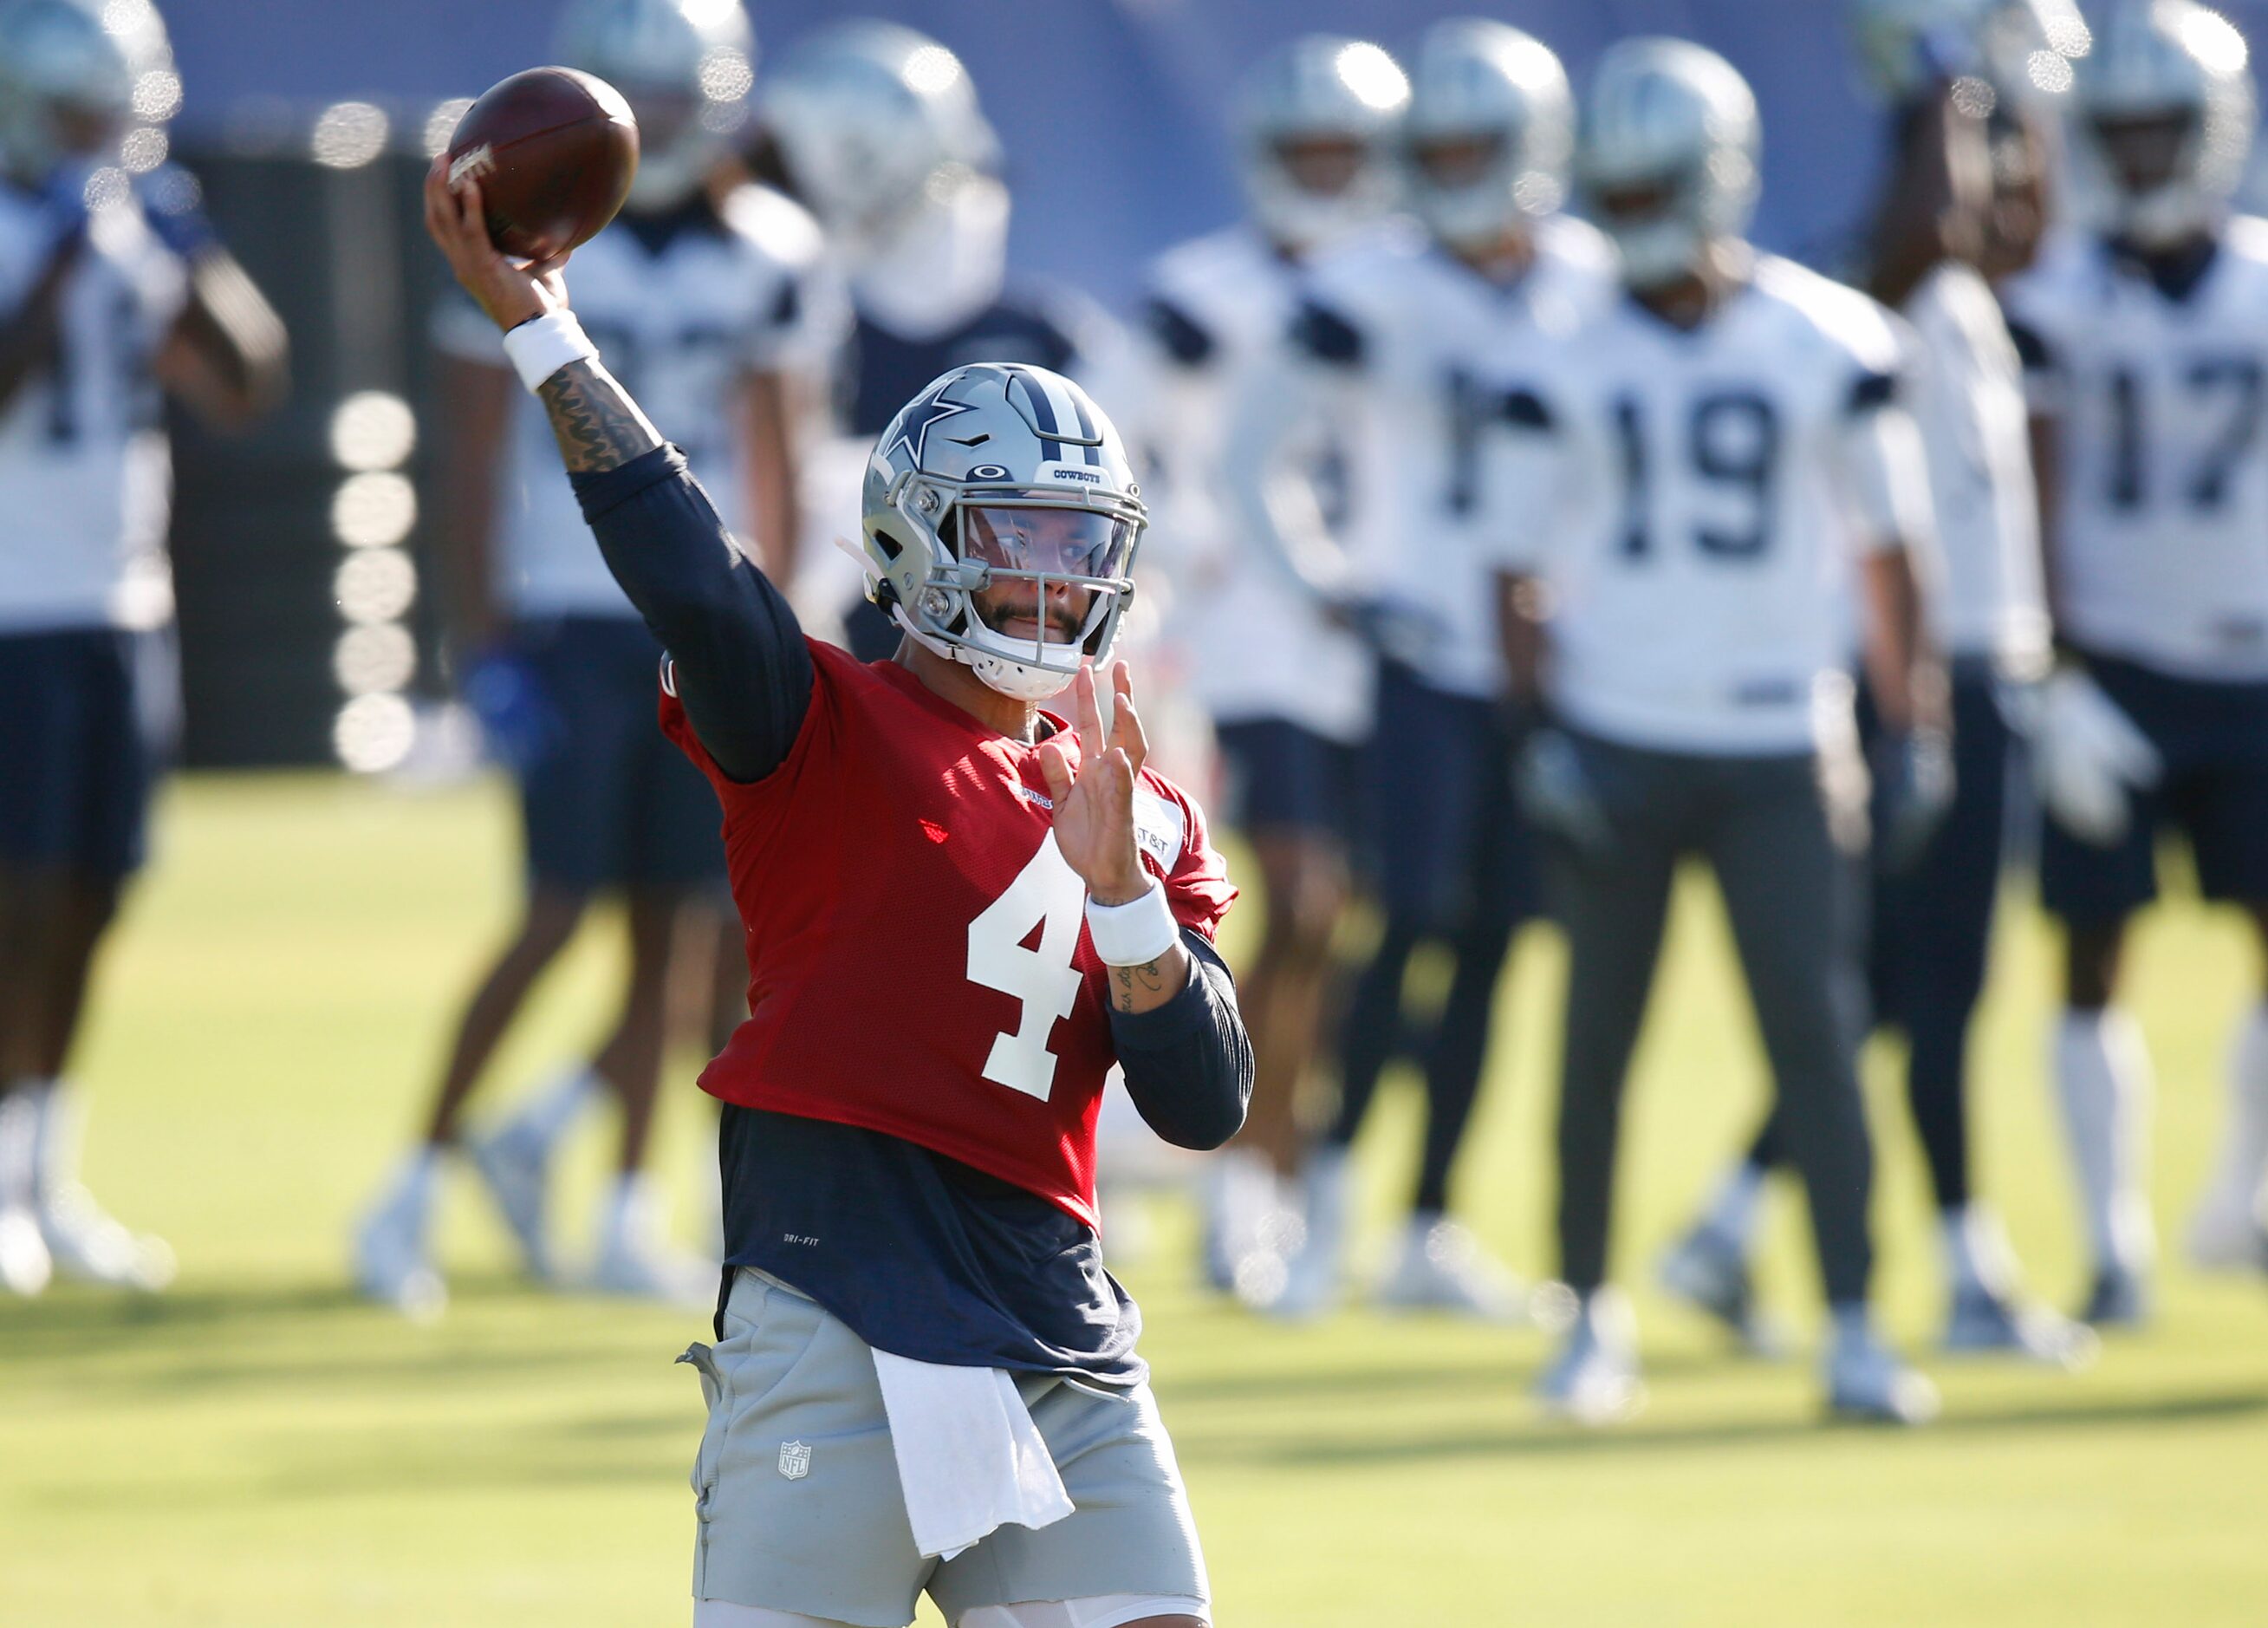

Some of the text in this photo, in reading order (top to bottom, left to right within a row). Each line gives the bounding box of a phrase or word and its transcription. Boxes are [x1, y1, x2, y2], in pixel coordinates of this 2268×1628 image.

[1054, 470, 1101, 484] COWBOYS
[1610, 384, 1780, 563] 19
[2109, 357, 2265, 511] 17
[965, 826, 1086, 1103] 4
[783, 1233, 819, 1247] DRI-FIT
[781, 1455, 807, 1475] NFL
